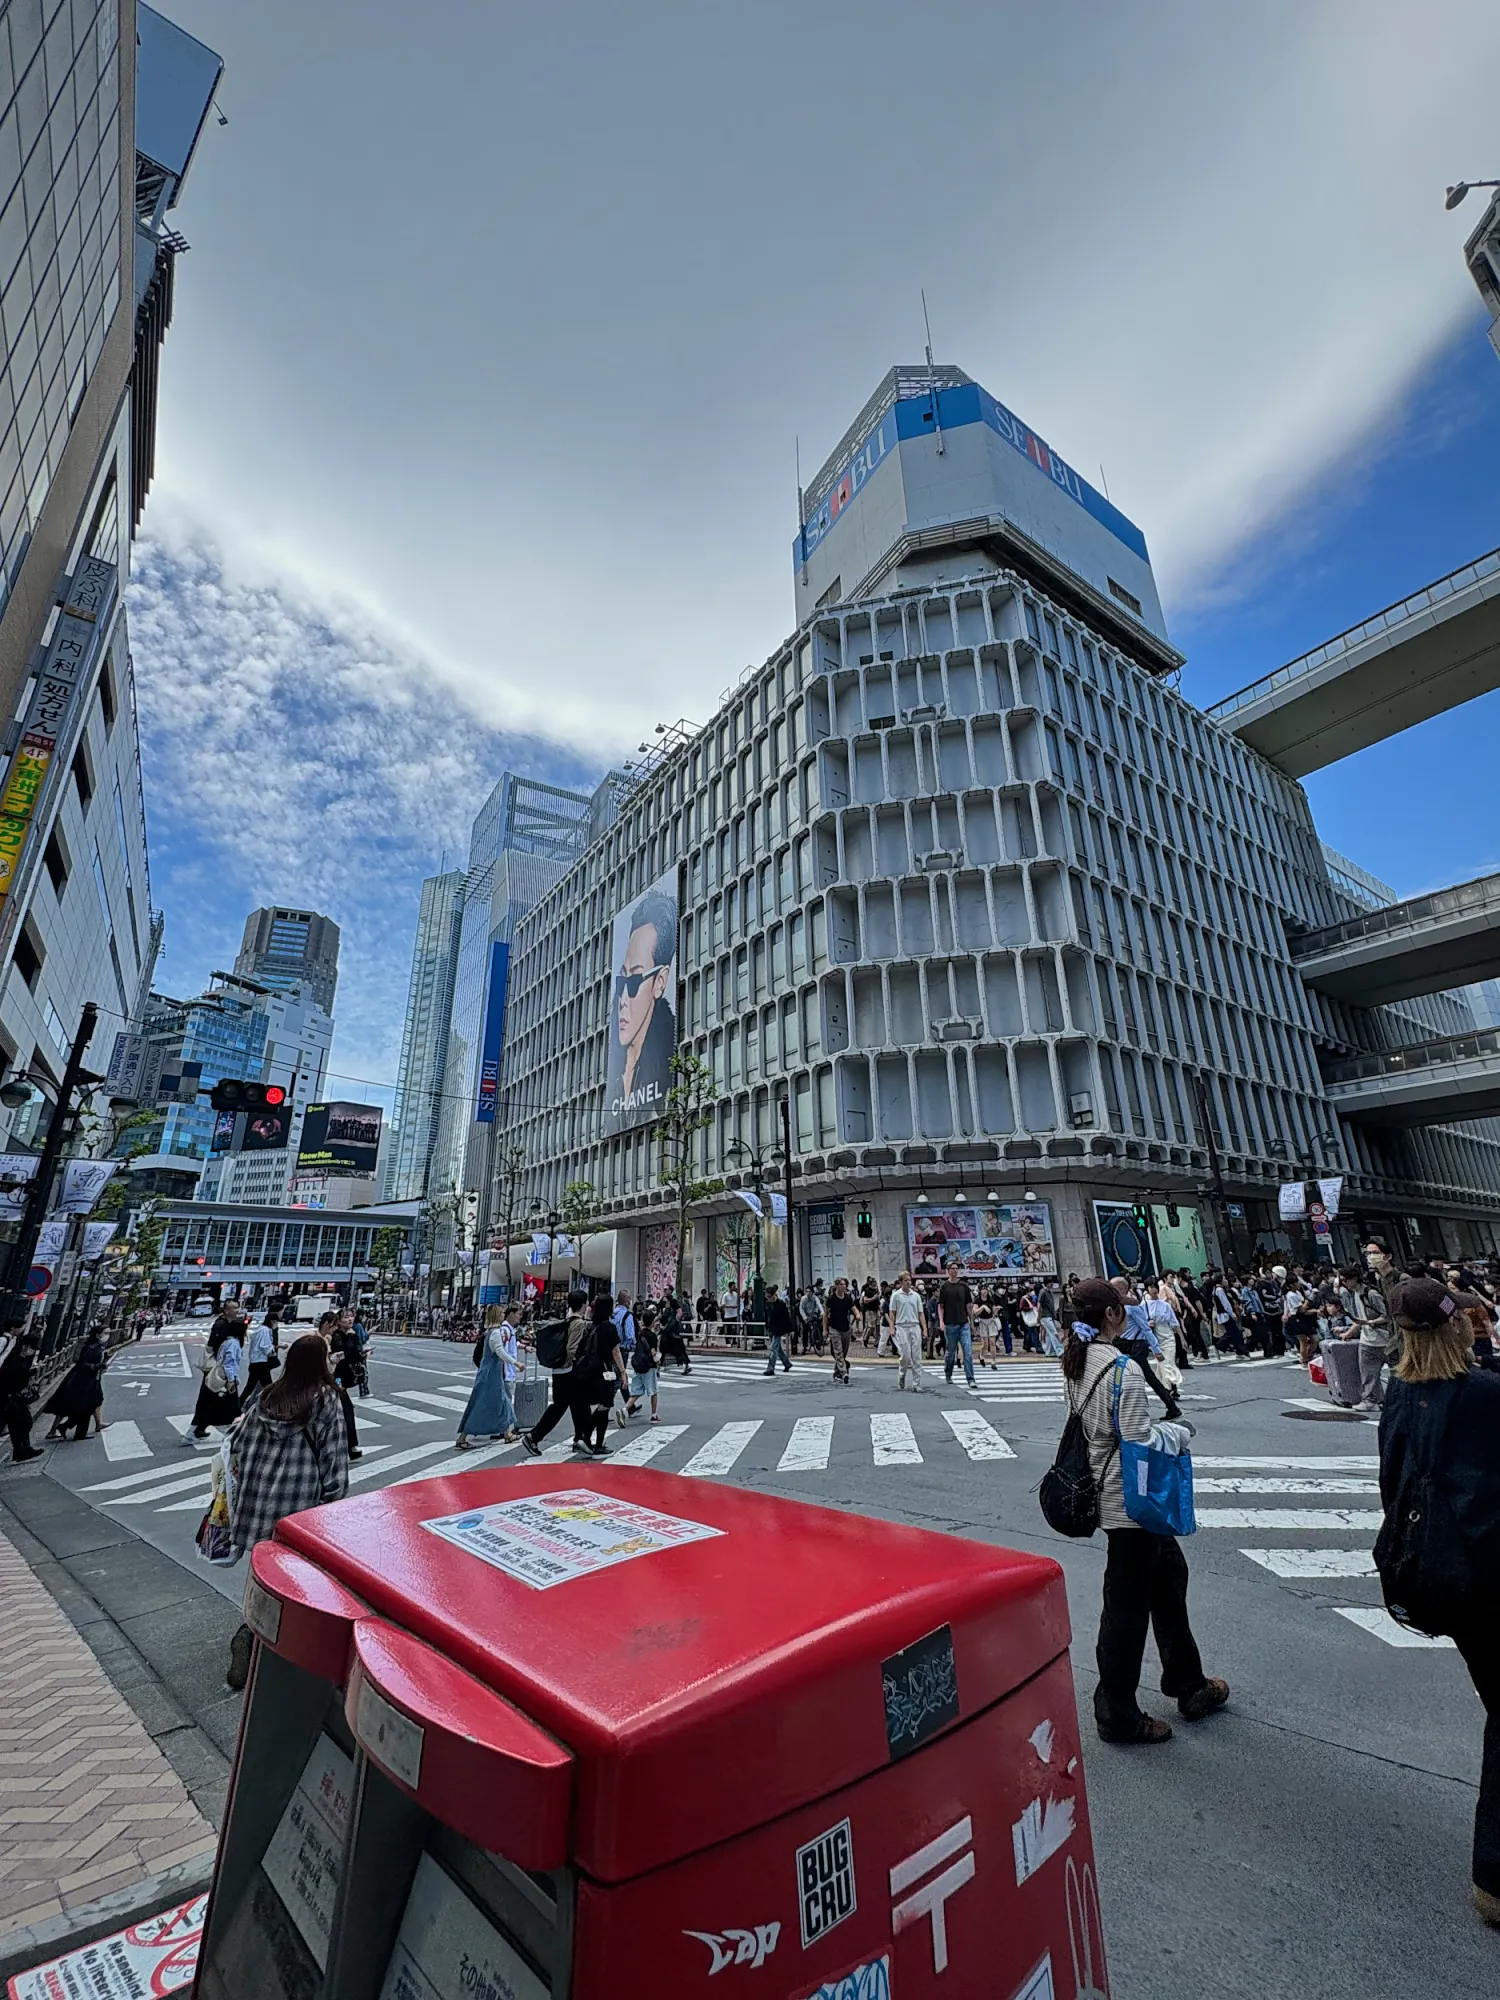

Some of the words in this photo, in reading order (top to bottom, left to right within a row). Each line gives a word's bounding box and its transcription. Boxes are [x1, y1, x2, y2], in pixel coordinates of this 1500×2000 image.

[996, 407, 1084, 504] SEIBU
[806, 428, 887, 554] SEIBU
[73, 562, 109, 611] 皮ふ科
[52, 639, 82, 677] 内科
[29, 682, 70, 735] 処方せん
[27, 749, 44, 759] 4F
[480, 1059, 498, 1111] SEIBU
[612, 1081, 662, 1117] CHANEL
[809, 1213, 827, 1226] SEIBU
[591, 1518, 650, 1538] Graffiti
[801, 1829, 848, 1895] BUG
[805, 1869, 852, 1938] CRU
[82, 1948, 99, 1966] No
[107, 1941, 124, 1956] No
[115, 1955, 148, 2000] smoking
